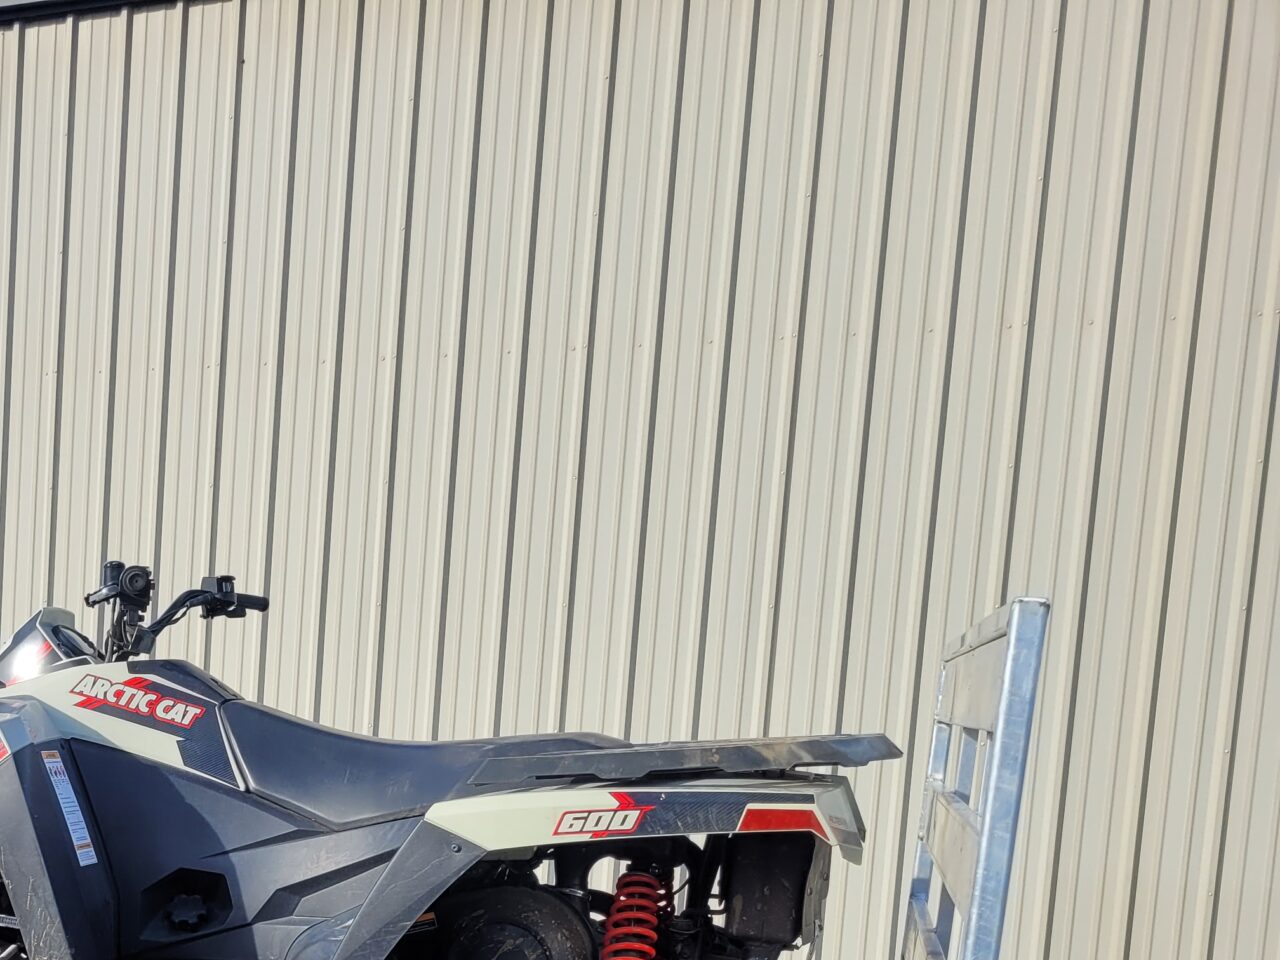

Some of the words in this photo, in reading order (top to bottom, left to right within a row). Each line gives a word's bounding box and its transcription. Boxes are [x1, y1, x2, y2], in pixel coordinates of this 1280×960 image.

[72, 675, 157, 713] ARCTIC
[155, 698, 202, 726] CAT
[555, 809, 642, 834] 600
